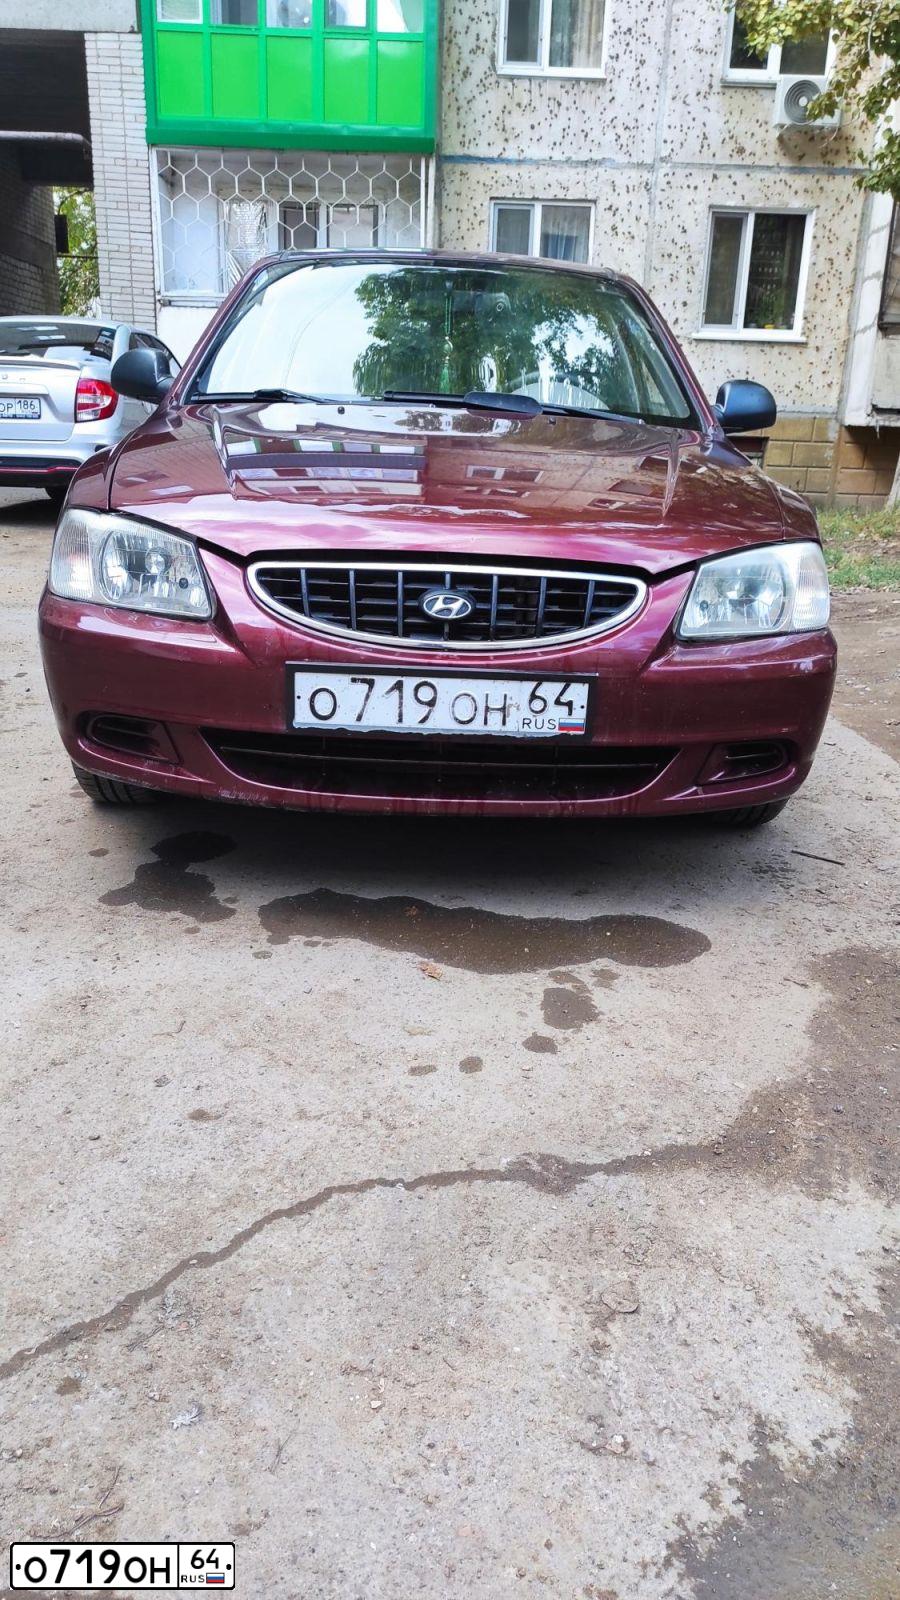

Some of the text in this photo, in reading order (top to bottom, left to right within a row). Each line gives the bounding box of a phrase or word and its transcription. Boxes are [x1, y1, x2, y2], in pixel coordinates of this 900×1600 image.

[17, 400, 36, 410] 186
[528, 681, 574, 716] 64
[522, 717, 557, 730] RUS
